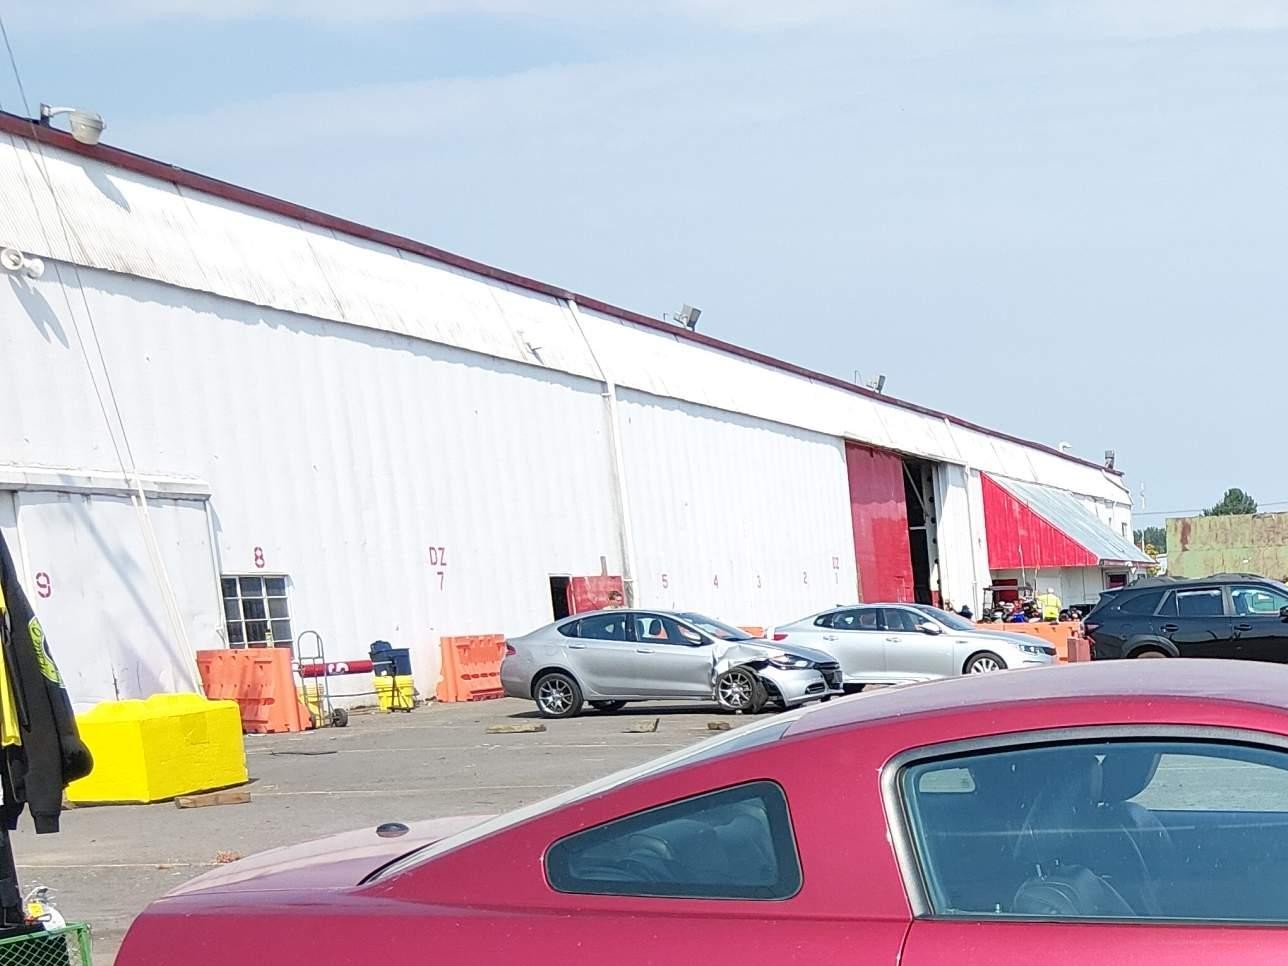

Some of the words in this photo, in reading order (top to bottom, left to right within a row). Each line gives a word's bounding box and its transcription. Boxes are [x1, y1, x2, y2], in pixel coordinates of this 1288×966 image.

[254, 546, 265, 568] 8
[429, 546, 447, 566] DZ
[35, 572, 52, 598] 9
[437, 571, 444, 591] 7
[661, 574, 669, 589] 5
[713, 574, 719, 589] 4
[803, 571, 808, 585] 2
